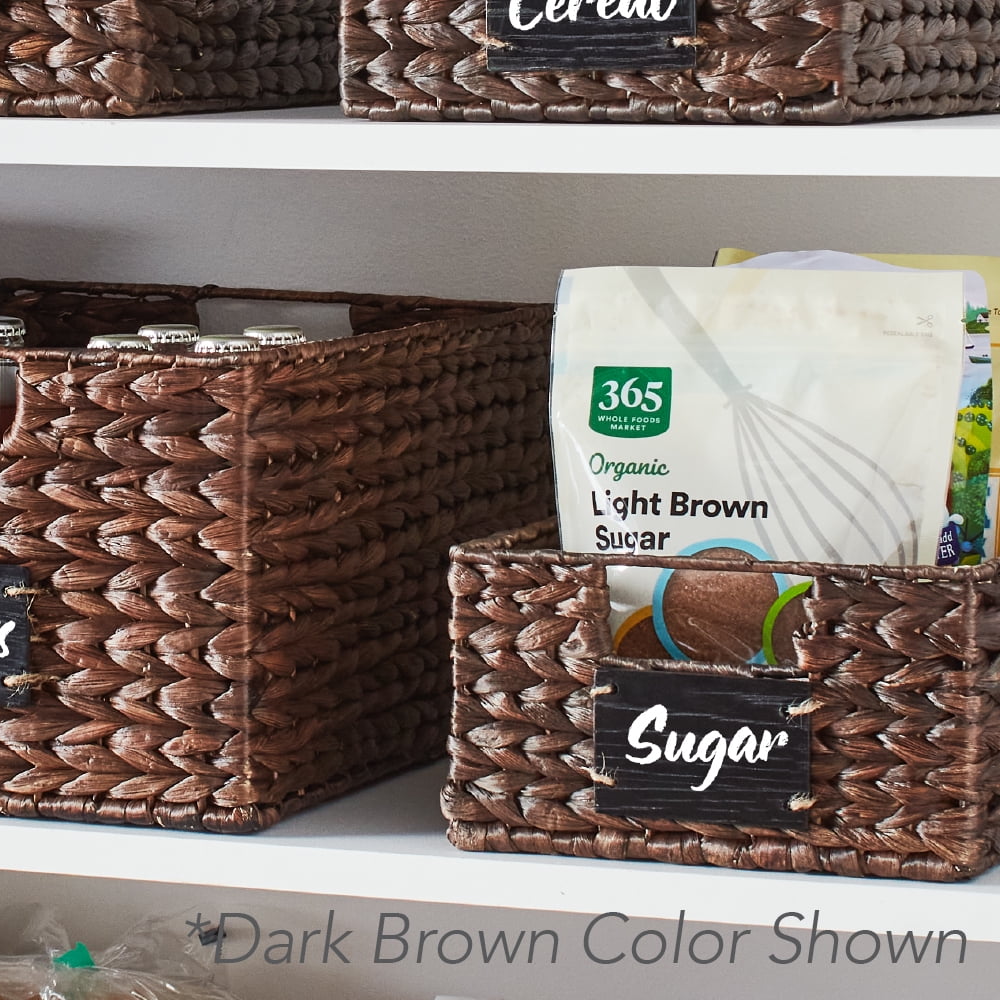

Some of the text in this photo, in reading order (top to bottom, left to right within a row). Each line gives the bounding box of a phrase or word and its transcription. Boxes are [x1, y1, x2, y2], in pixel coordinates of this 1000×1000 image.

[598, 377, 663, 412] 365
[597, 415, 661, 424] WHOLE FOODS
[610, 423, 647, 432] MARKET
[589, 452, 670, 482] Organic
[591, 489, 769, 521] Light Brown
[595, 524, 671, 554] Sugar
[625, 703, 789, 792] Sugar
